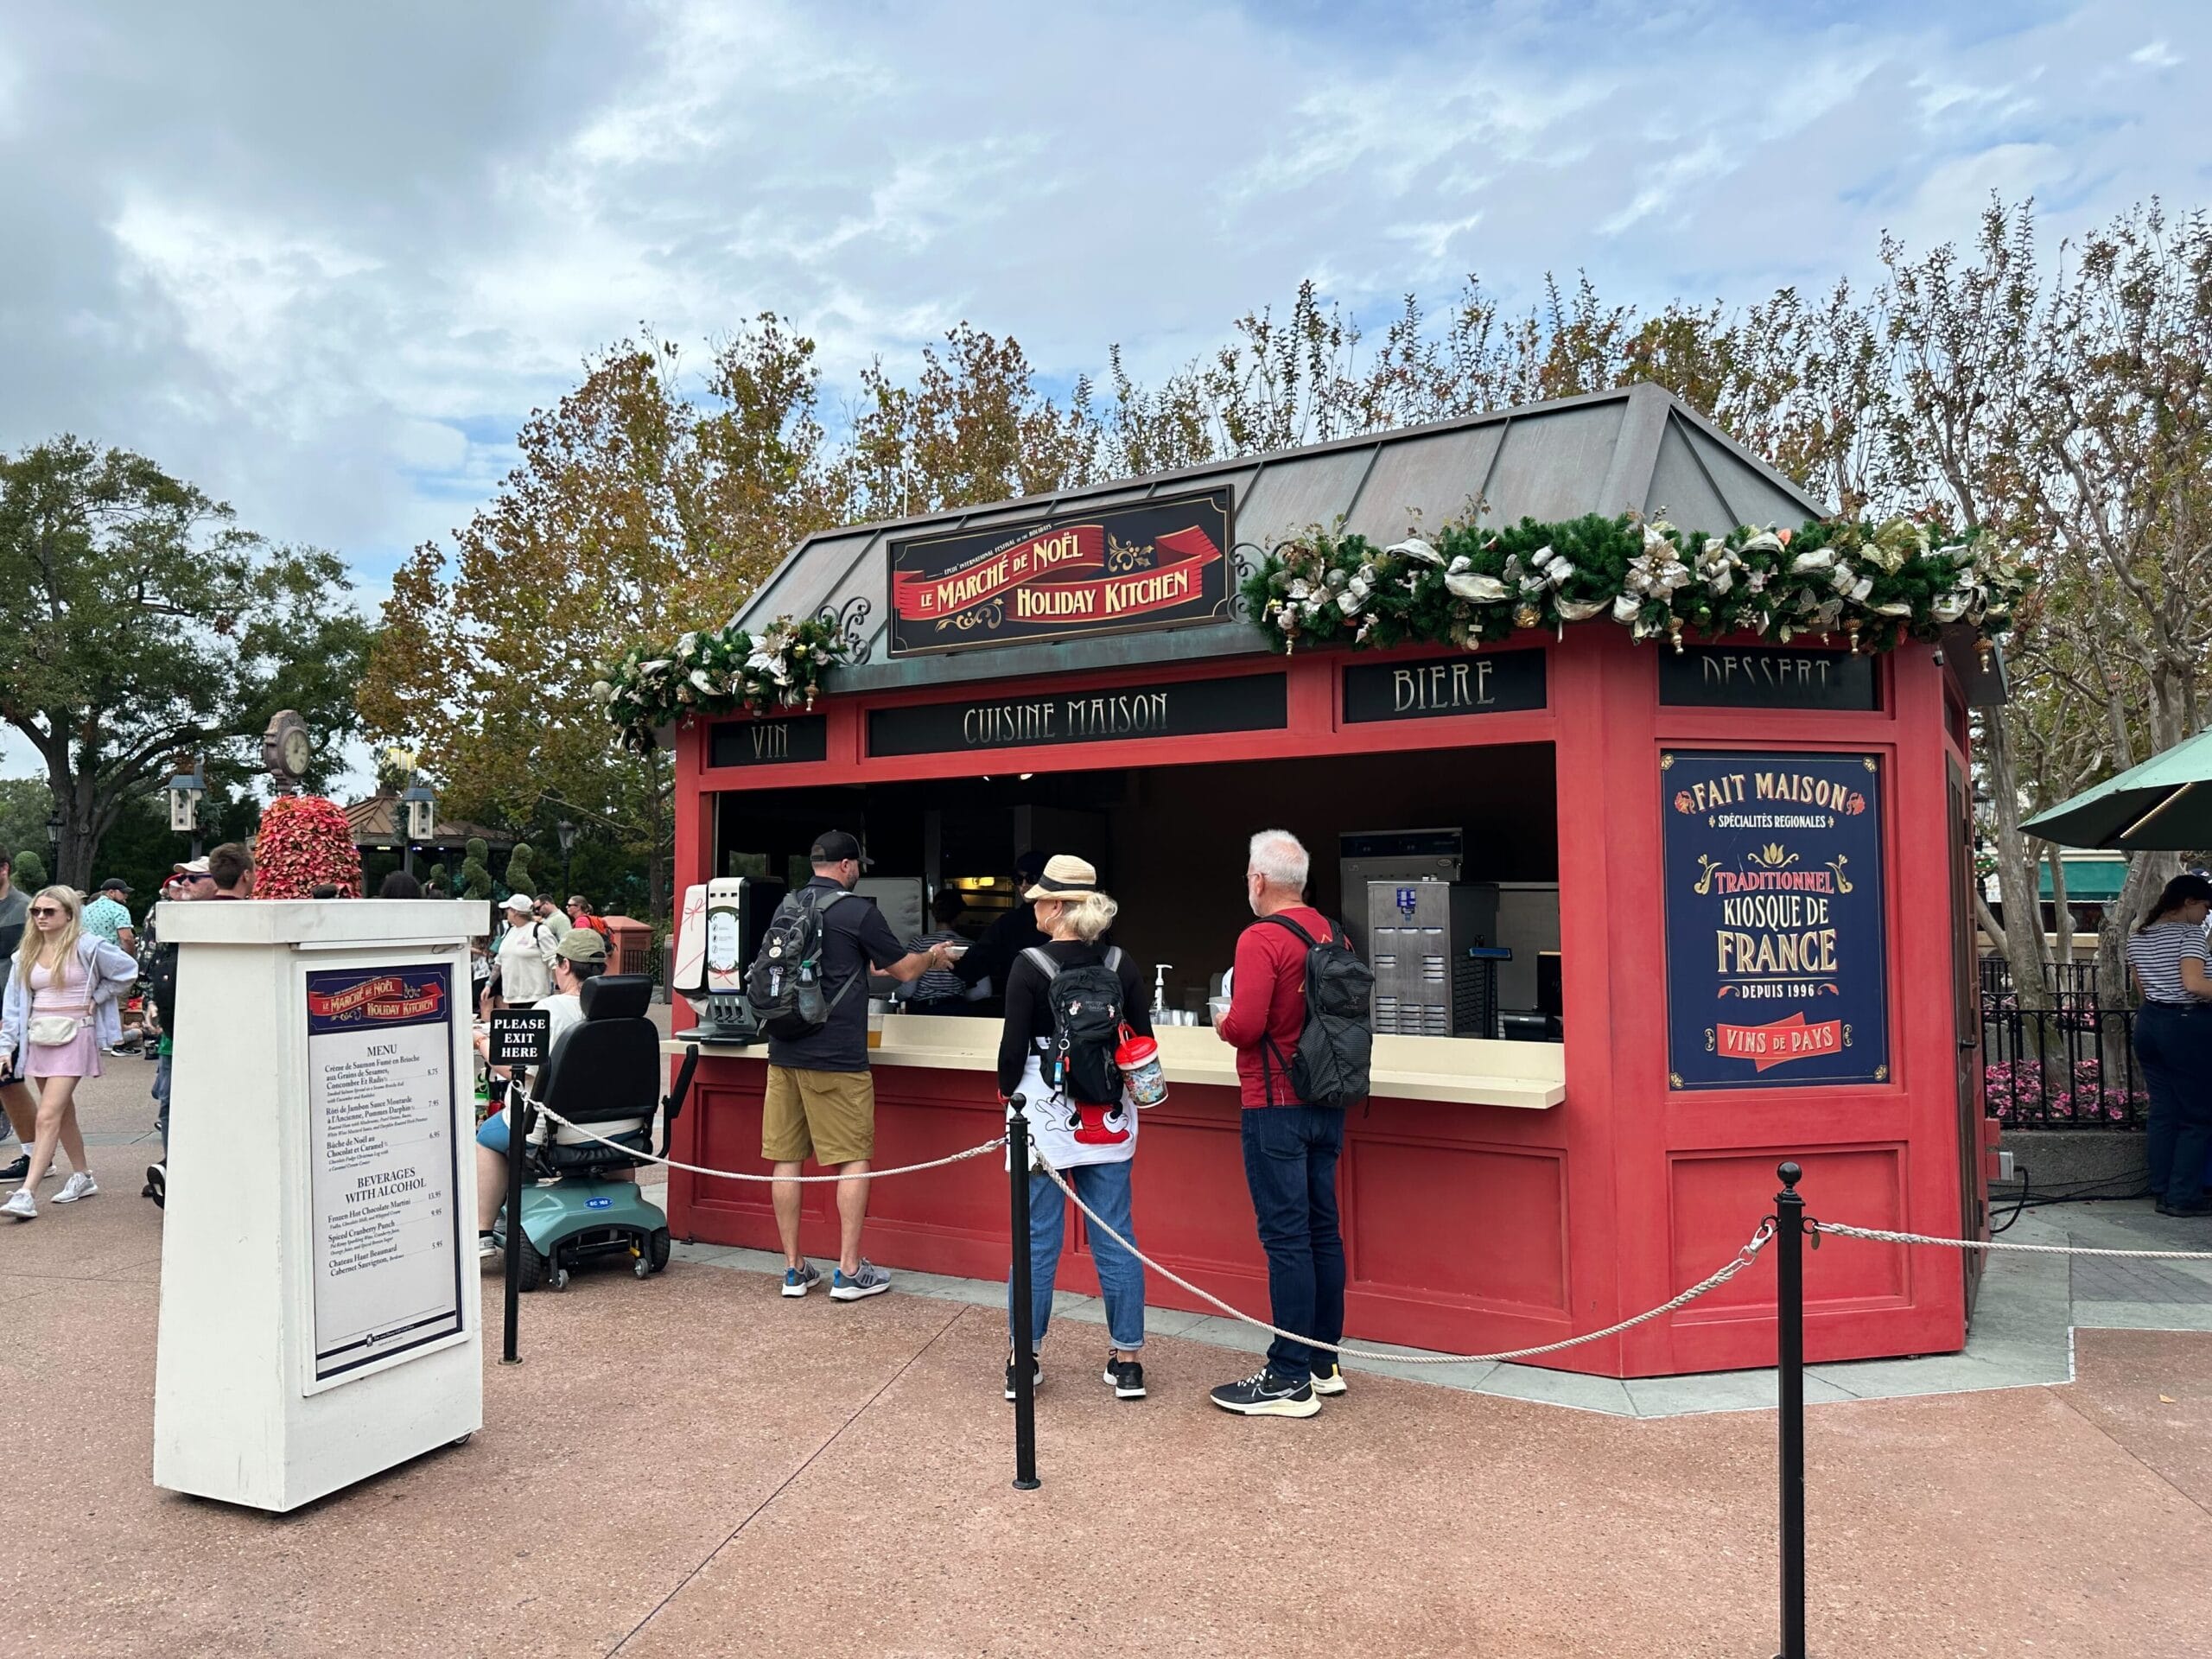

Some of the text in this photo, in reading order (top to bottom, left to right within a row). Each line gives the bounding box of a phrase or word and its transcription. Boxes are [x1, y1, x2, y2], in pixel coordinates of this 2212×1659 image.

[959, 550, 994, 569] INTERNATIONAL
[995, 539, 1015, 553] FESTIVAL
[1029, 524, 1052, 537] HOLIDAYS
[920, 532, 1083, 613] LE MARCHÉ DE NOËL
[1017, 570, 1188, 617] HOLIDAY KITCHEN
[963, 693, 1167, 744] CUISINE MAISON
[752, 724, 789, 760] VIN
[1692, 772, 1849, 813] FAIT MAISON
[1719, 812, 1826, 828] SPÉCIALITÉS REGIONALES
[1715, 872, 1834, 894] TRADITIONNEL
[1724, 896, 1829, 931] KIOSQUE DE
[1716, 929, 1838, 973] FRANCE
[331, 986, 365, 1012] MARCHÉ
[374, 980, 394, 995] NOËL
[1742, 984, 1815, 998] DEPUIS 1996
[367, 999, 433, 1016] HOLIDAY KITCHEN
[494, 1019, 545, 1029] PLEASE
[505, 1033, 535, 1043] EXIT
[1727, 1027, 1834, 1052] VINS DE PAYS
[367, 1044, 397, 1057] MENU
[501, 1047, 537, 1058] HERE
[327, 1078, 359, 1090] Concombre
[338, 1071, 356, 1079] Grains
[347, 1103, 368, 1113] Jambon
[387, 1096, 412, 1105] Moutarde
[354, 1135, 367, 1144] Noël
[327, 1147, 353, 1158] Chocolat
[360, 1141, 383, 1152] Caramel
[358, 1167, 416, 1188] BEVERAGES
[346, 1178, 427, 1204] WITH ALCOHOL
[429, 1192, 441, 1200] 13.95
[328, 1198, 410, 1223] Frozen Hot Chocolate Martini
[431, 1208, 442, 1217] 9.95
[328, 1220, 395, 1243] Spiced Cranberry Punch
[432, 1241, 442, 1249] 5.95
[329, 1258, 353, 1268] Chateau
[331, 1264, 356, 1276] Cabernet
[359, 1257, 389, 1269] Sauvignon,
